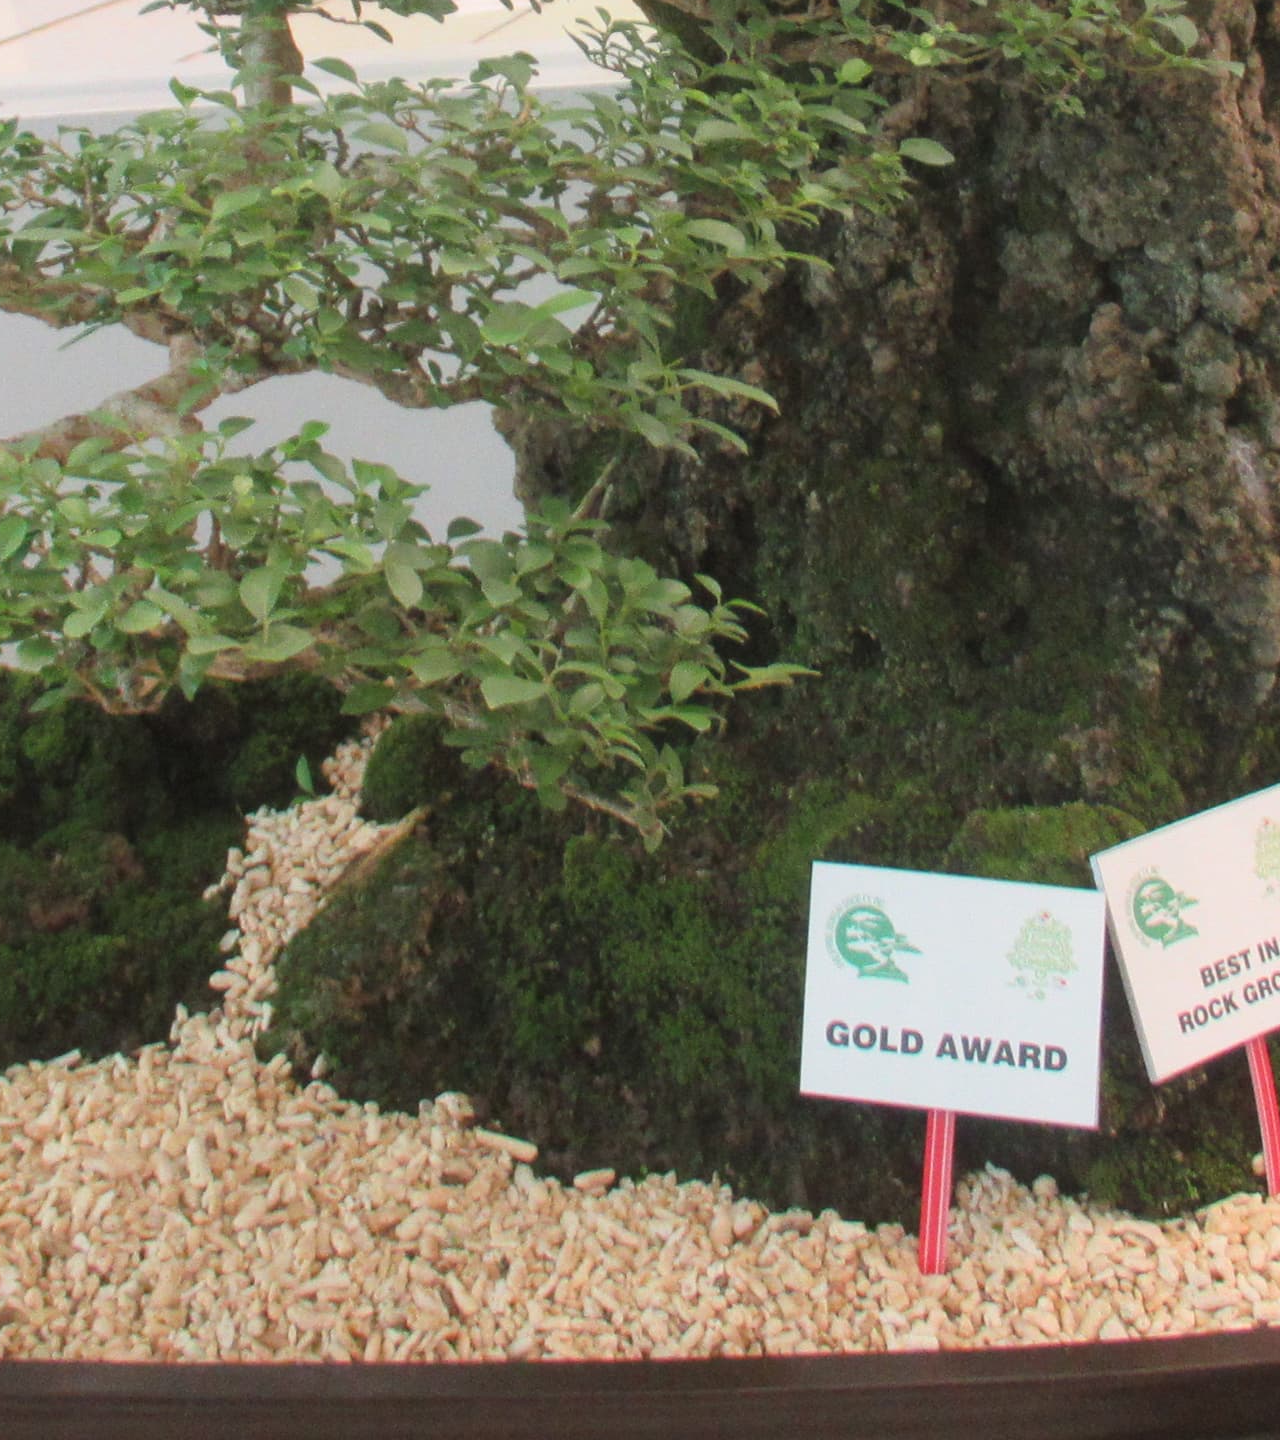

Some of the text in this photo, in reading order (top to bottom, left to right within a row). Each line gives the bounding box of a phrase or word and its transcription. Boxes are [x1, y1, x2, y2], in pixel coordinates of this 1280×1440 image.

[1199, 936, 1280, 987] BEST IN
[1177, 991, 1239, 1033] ROCK
[825, 1019, 1068, 1072] GOLD AWARD
